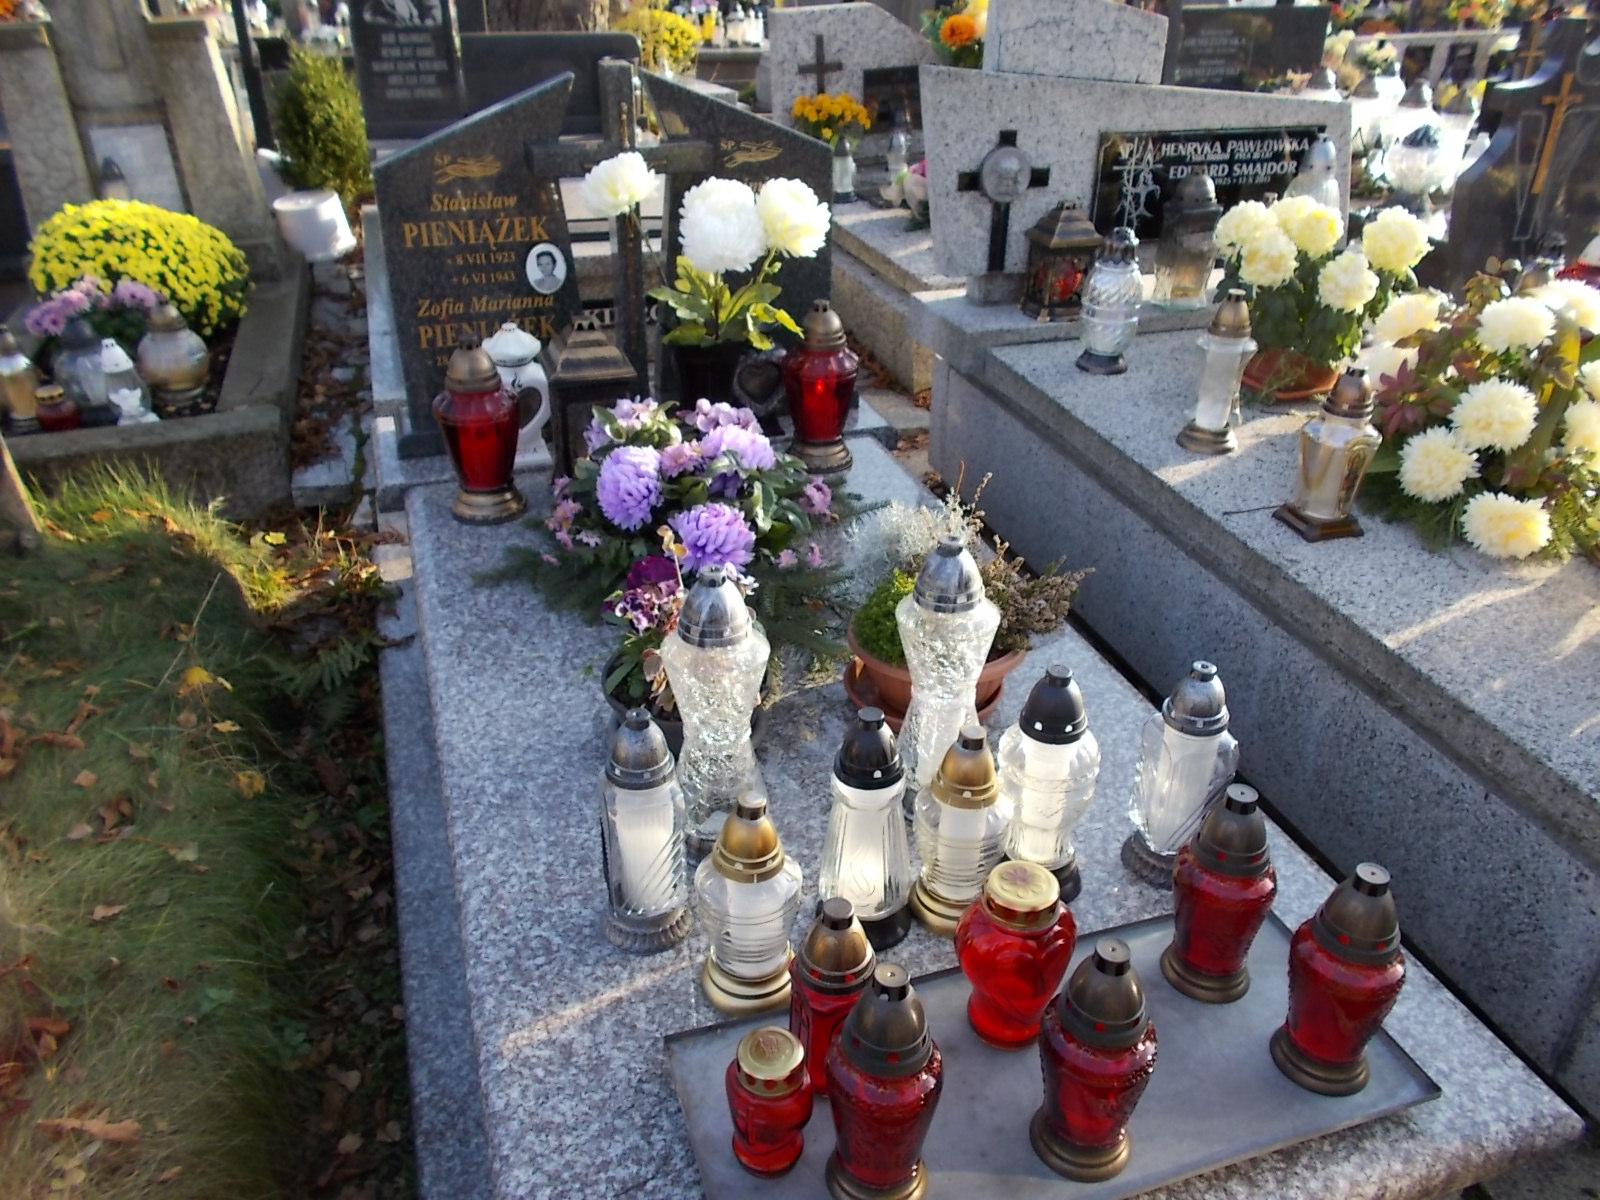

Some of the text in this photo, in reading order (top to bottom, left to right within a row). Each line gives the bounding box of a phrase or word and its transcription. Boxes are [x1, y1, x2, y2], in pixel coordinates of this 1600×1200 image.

[1161, 141, 1222, 157] HENRYKA
[1227, 137, 1309, 153] PAWŁOWSKA
[1168, 161, 1298, 180] EDRD SMAJDOR
[402, 212, 549, 250] PIENIĄŻEK
[417, 294, 554, 319] Zofia Marianna
[418, 313, 558, 349] PIENIEK
